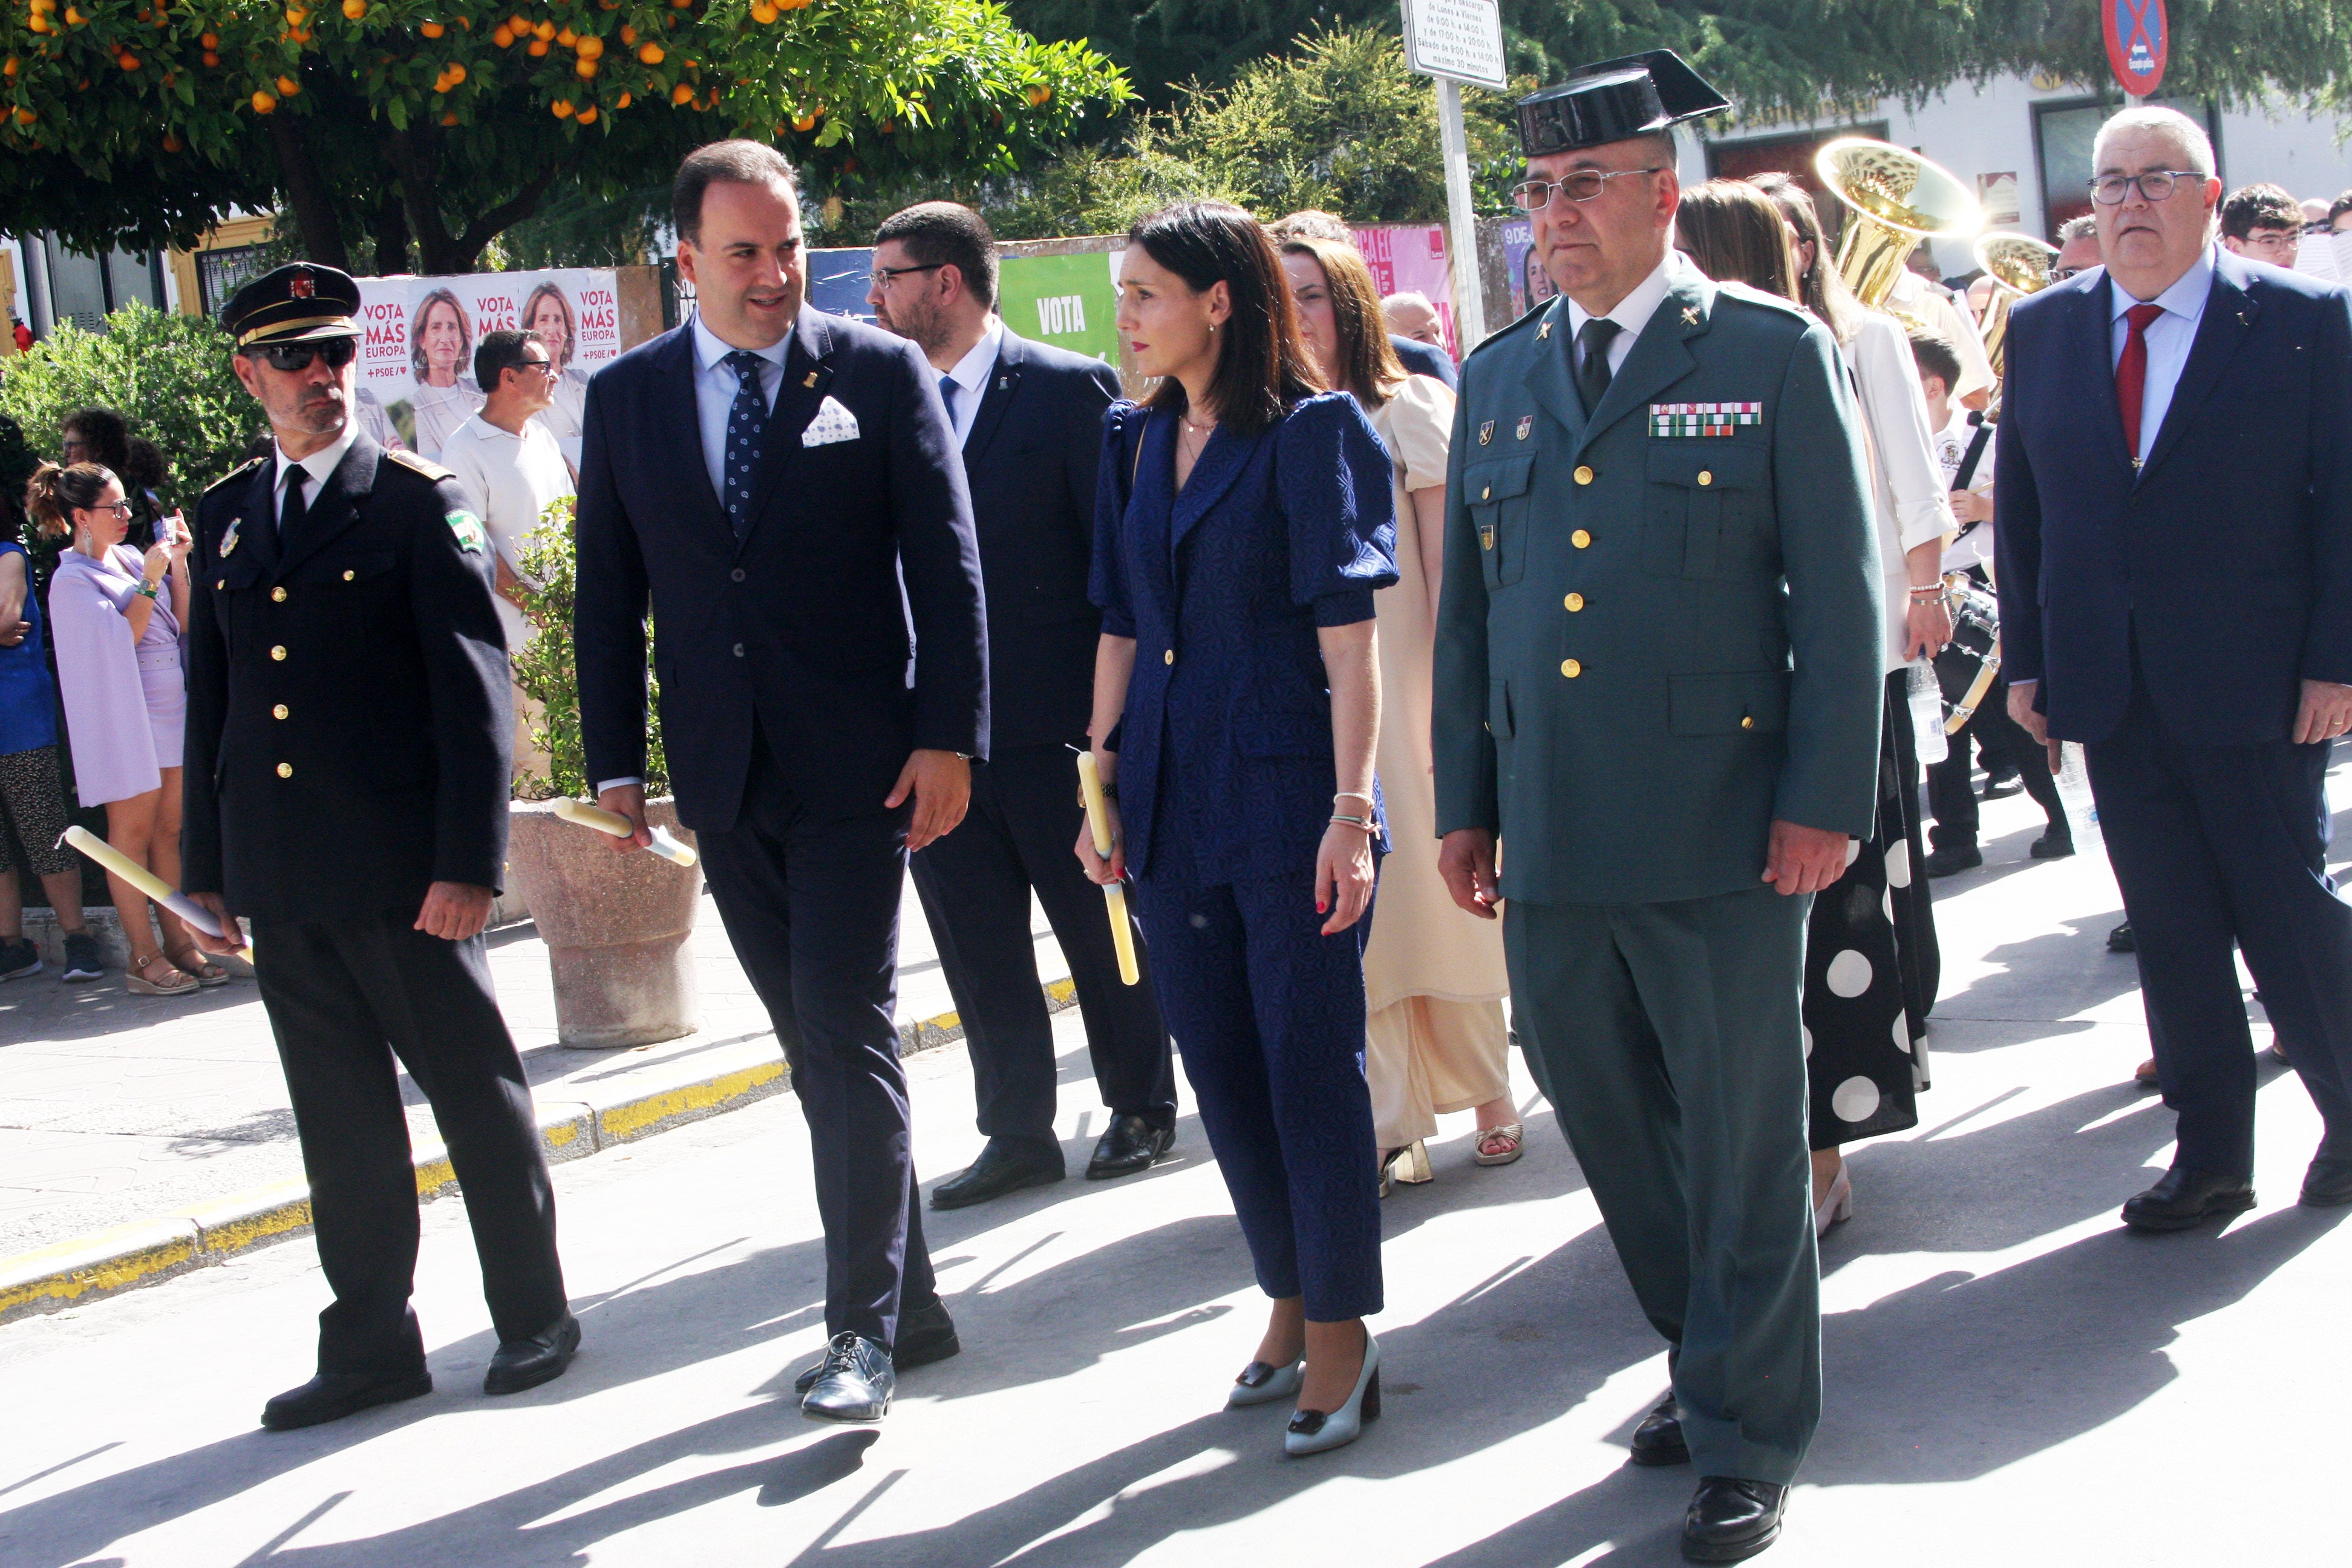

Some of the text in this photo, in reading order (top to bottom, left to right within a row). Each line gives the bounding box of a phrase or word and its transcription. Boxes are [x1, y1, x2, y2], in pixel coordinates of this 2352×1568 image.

[1429, 1, 1436, 11] de
[1437, 4, 1454, 16] Lunes
[1427, 14, 1434, 24] de
[1464, 23, 1479, 34] 14:00
[1423, 27, 1427, 36] y
[1429, 27, 1437, 37] de
[1439, 29, 1454, 41] 17:00
[1468, 36, 1485, 48] 20:00
[1442, 42, 1448, 52] de
[1450, 45, 1464, 56] 9:00
[1478, 51, 1494, 63] 14:00
[1457, 59, 1465, 68] 30
[1467, 62, 1488, 74] minutos
[477, 296, 514, 313] VOTA
[580, 290, 613, 305] VOTA
[364, 304, 405, 321] VOTA
[581, 306, 615, 330] MÁS
[1036, 295, 1086, 336] VOTA
[365, 320, 406, 345] MÁS
[479, 312, 515, 338] MÁS
[582, 330, 615, 341] EUROPA
[366, 345, 406, 358] EUROPA
